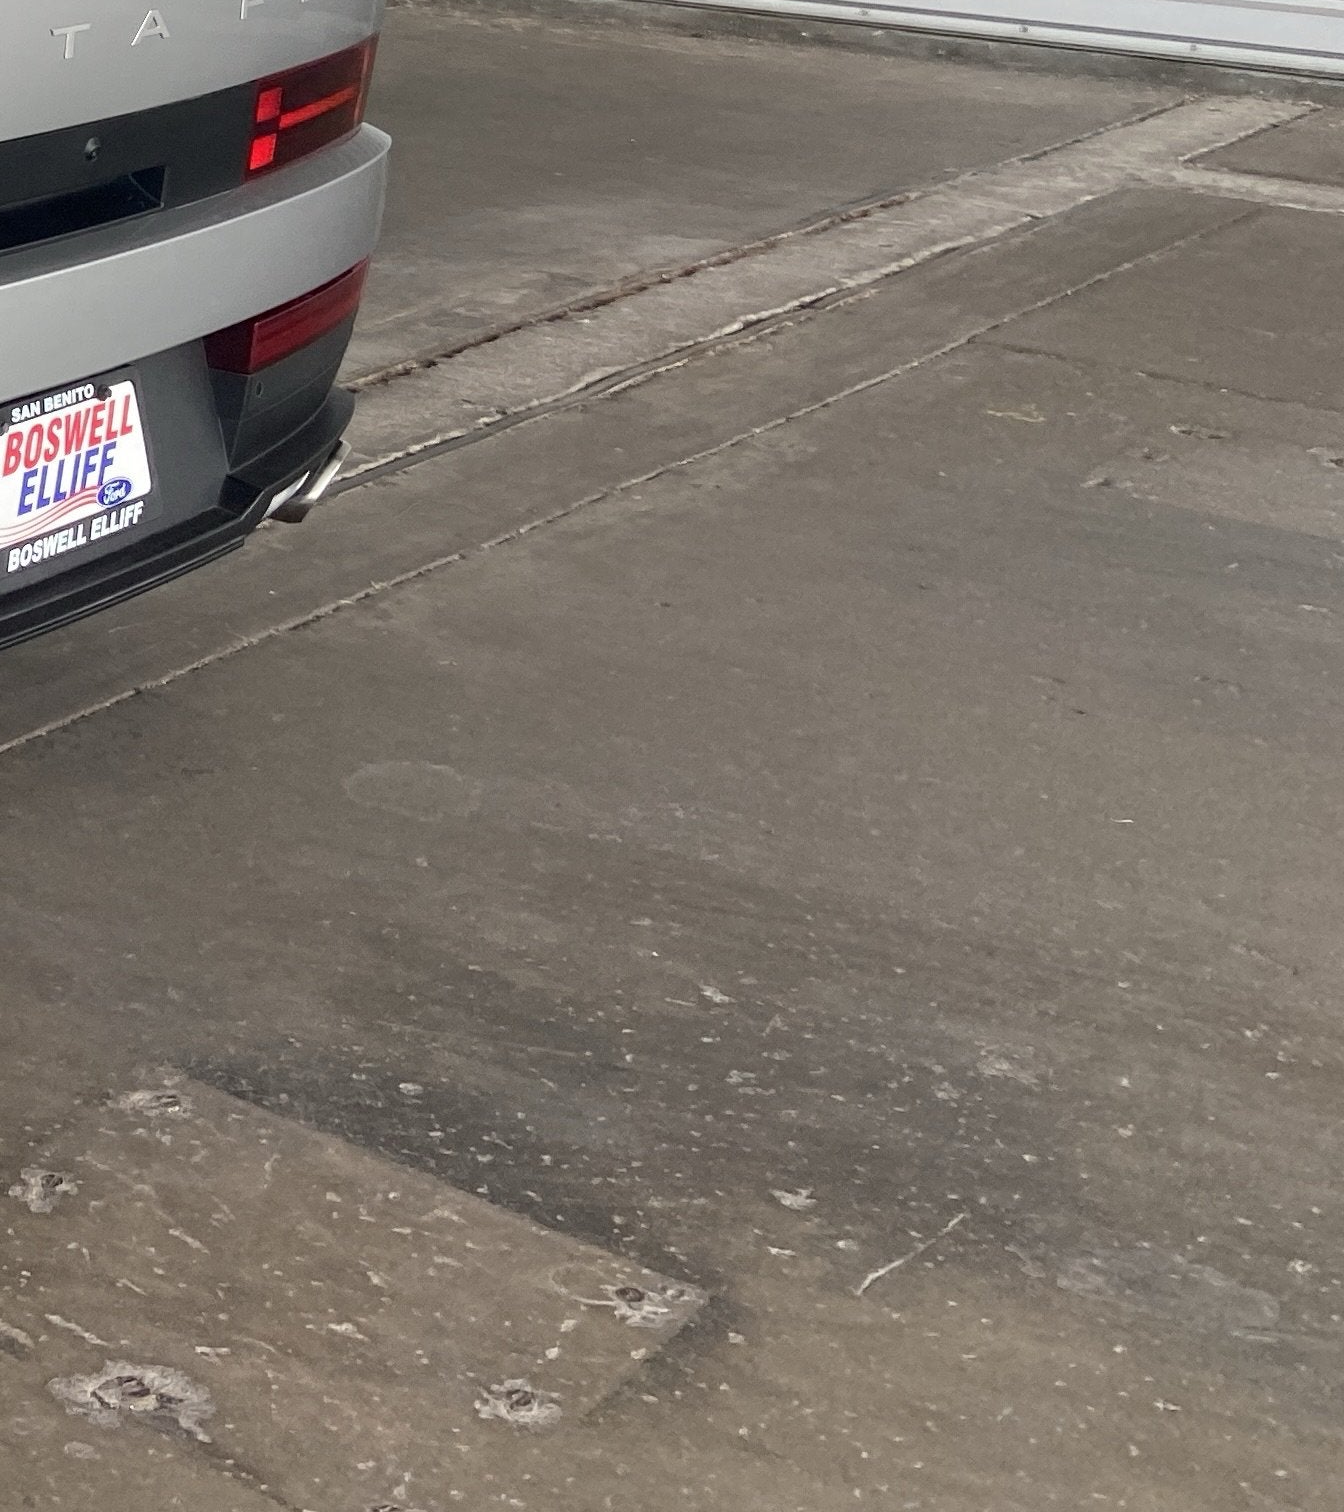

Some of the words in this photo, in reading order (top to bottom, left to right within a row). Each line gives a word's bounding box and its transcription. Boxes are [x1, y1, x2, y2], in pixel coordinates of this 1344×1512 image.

[2, 394, 133, 477] BOSWELL
[11, 400, 41, 423] SAN
[43, 383, 95, 412] BENITO
[17, 441, 117, 517] ELLIFF
[102, 480, 129, 507] Ford
[7, 523, 87, 573] BOSWELL
[90, 501, 144, 541] ELLIFF
